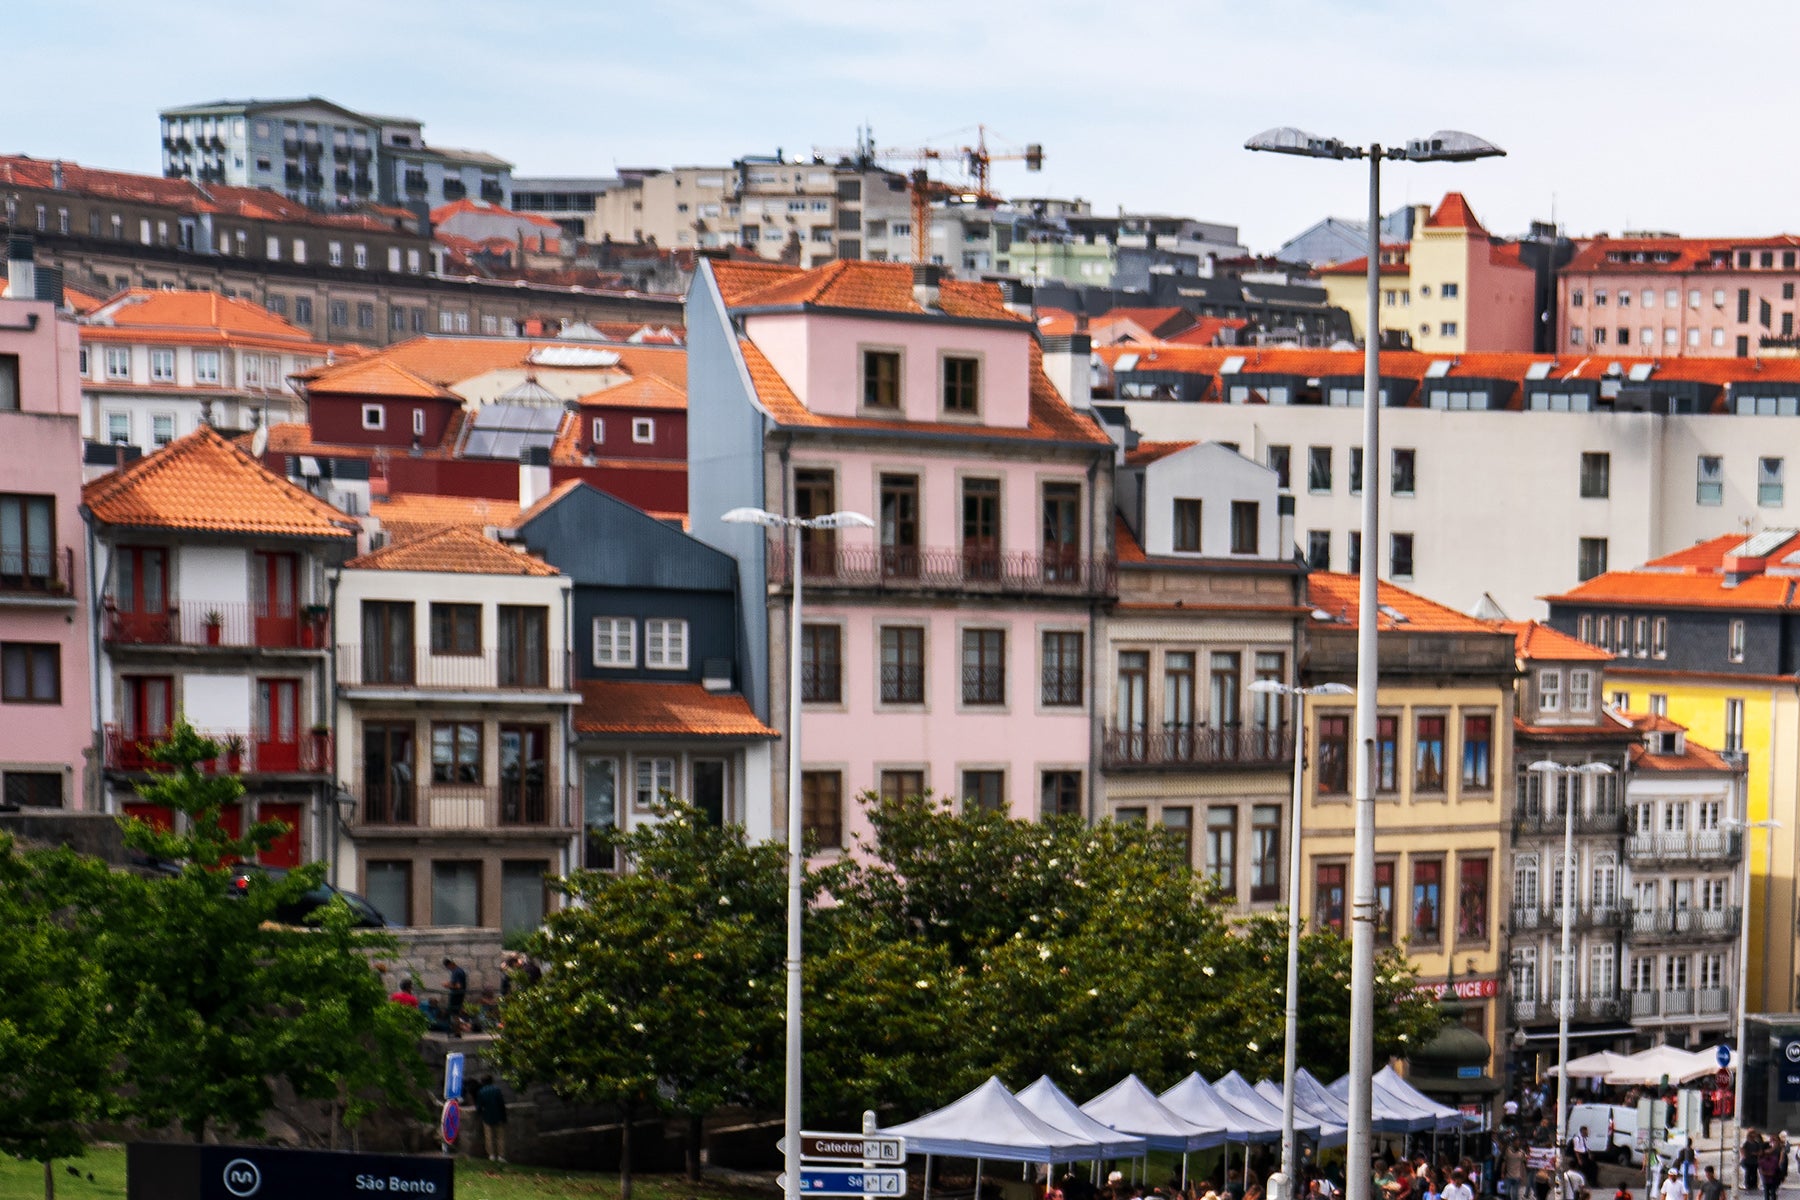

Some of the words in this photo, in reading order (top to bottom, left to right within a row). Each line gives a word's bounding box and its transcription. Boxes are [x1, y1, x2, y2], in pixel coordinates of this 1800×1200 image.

[1434, 982, 1482, 1000] SEVICE
[815, 1140, 863, 1153] Catedral
[355, 1174, 385, 1191] São
[389, 1177, 436, 1194] Bento
[848, 1175, 863, 1187] Sé
